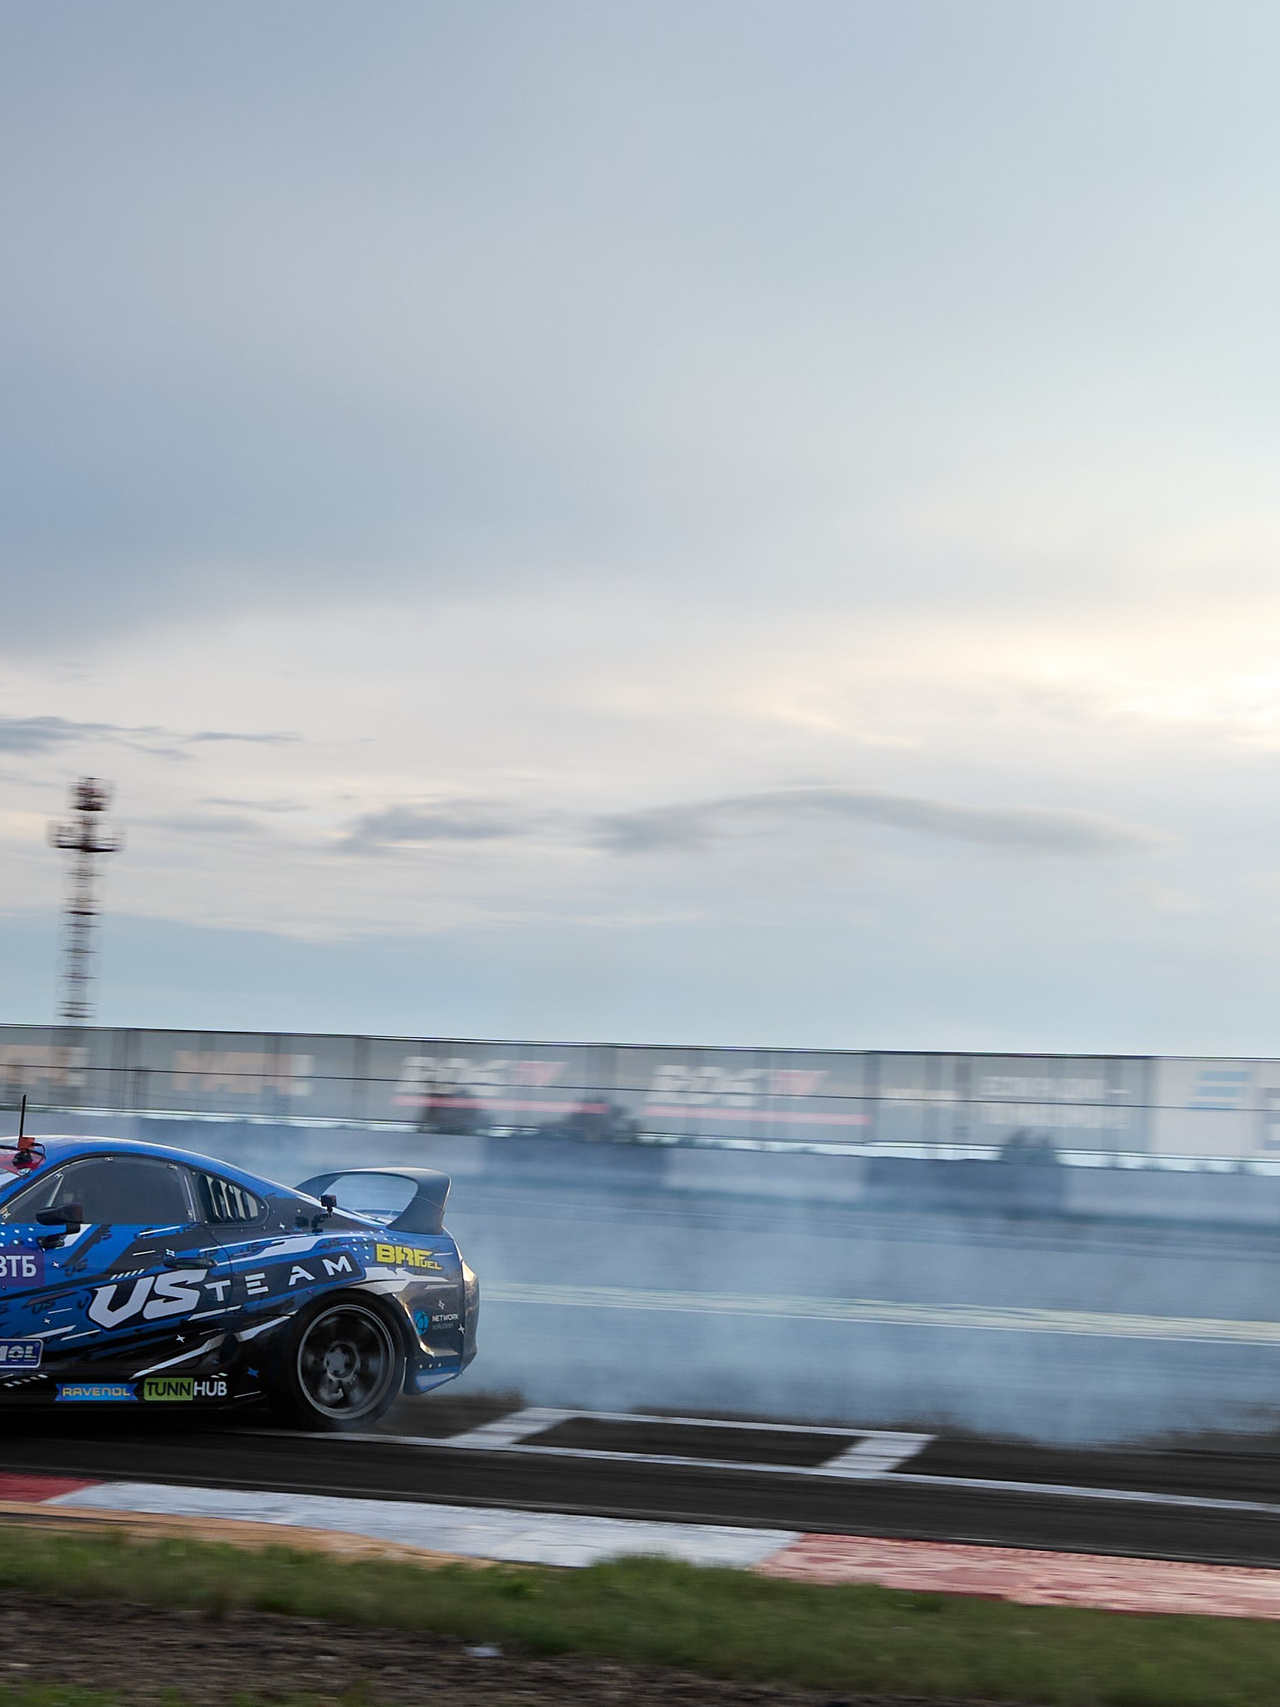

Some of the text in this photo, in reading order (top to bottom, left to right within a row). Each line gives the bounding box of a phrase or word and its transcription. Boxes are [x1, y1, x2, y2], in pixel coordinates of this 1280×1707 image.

[88, 1255, 353, 1329] US TEAM
[431, 1313, 461, 1323] NETWORK
[62, 1387, 131, 1396] RAVENOL
